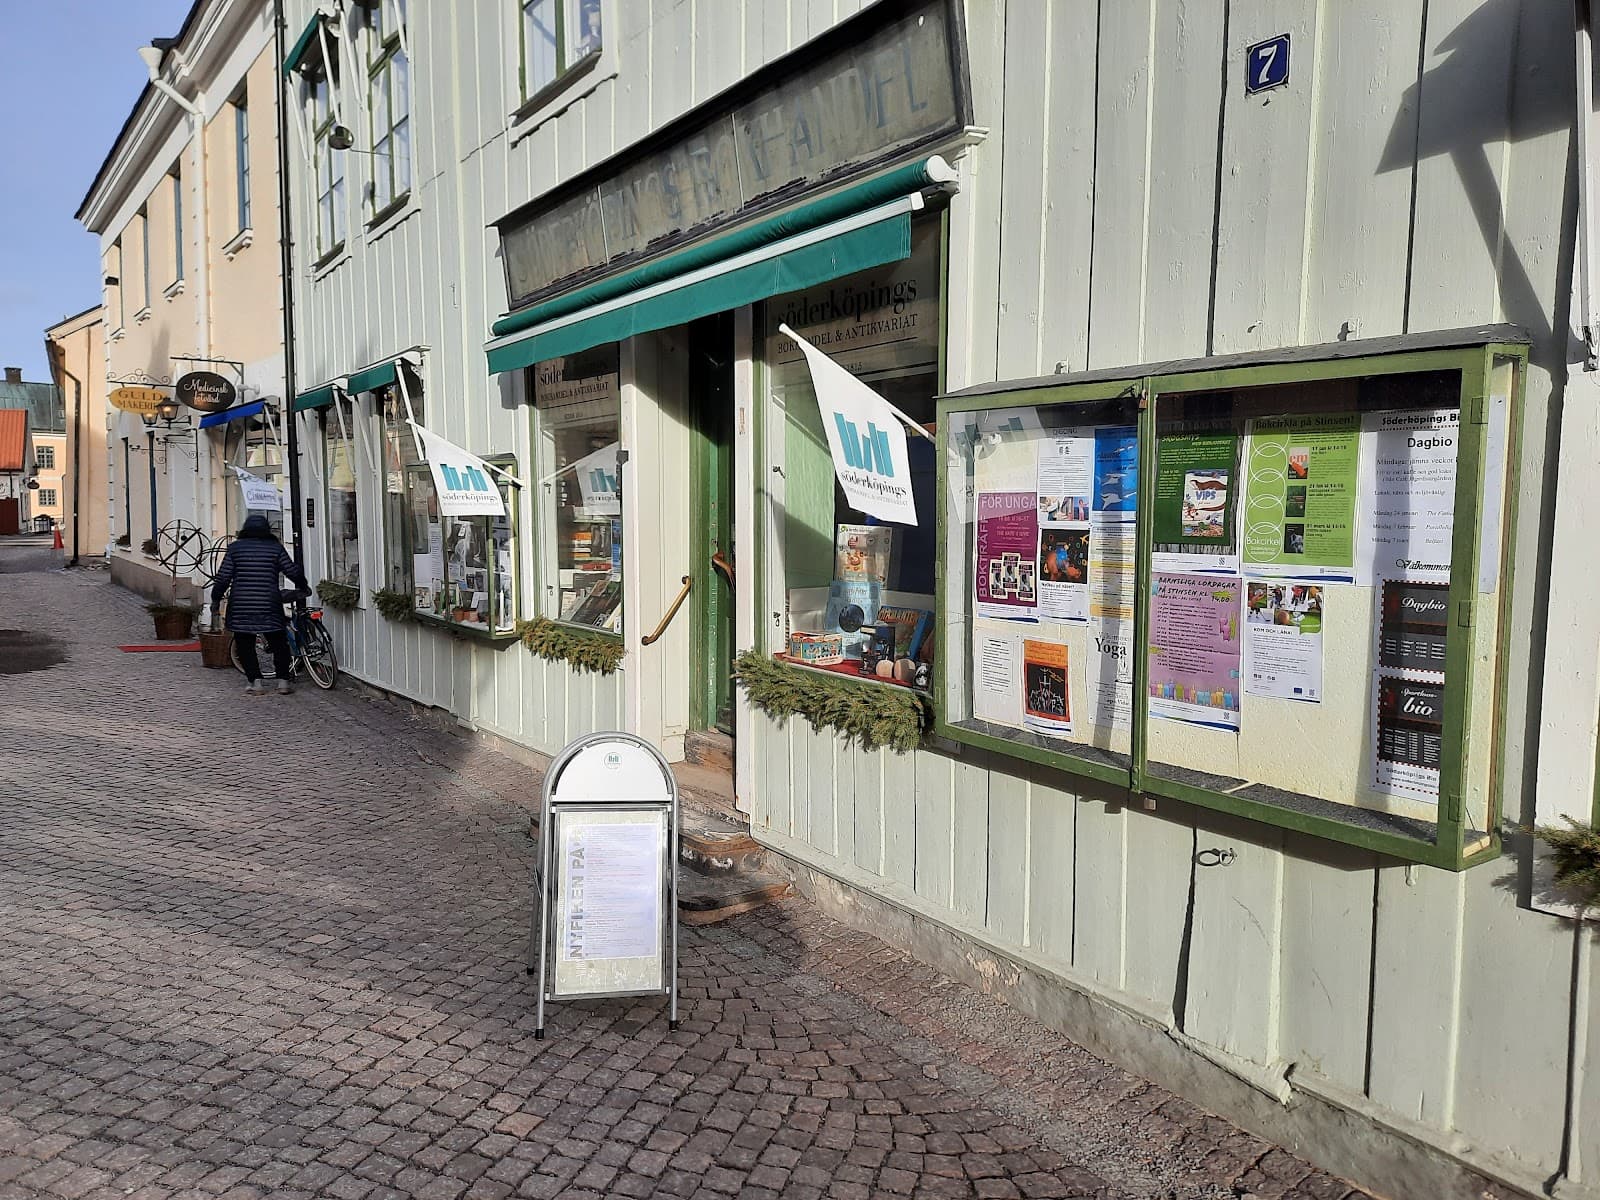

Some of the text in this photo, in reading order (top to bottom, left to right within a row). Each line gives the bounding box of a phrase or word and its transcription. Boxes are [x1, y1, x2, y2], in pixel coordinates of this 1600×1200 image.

[1259, 44, 1277, 84] 7
[778, 279, 917, 326] söderköpings
[778, 313, 918, 354] BOKNDEL & ANTIKVARIAT
[118, 389, 163, 401] GULD
[1382, 413, 1447, 425] Söderköpings
[1407, 436, 1453, 450] Dagbio
[840, 469, 908, 500] söderköpings
[442, 492, 498, 504] söderköpings
[981, 494, 1037, 510] FÖR UNGA
[978, 514, 989, 598] BOKTRÄFF
[1158, 577, 1237, 590] BARNSLIGA LÖRDAGAR
[1168, 587, 1198, 596] STINSEN
[1401, 597, 1446, 612] Dagbio
[1095, 637, 1127, 659] Yoga
[1403, 697, 1434, 716] bio
[570, 876, 585, 958] NYFIKEN
